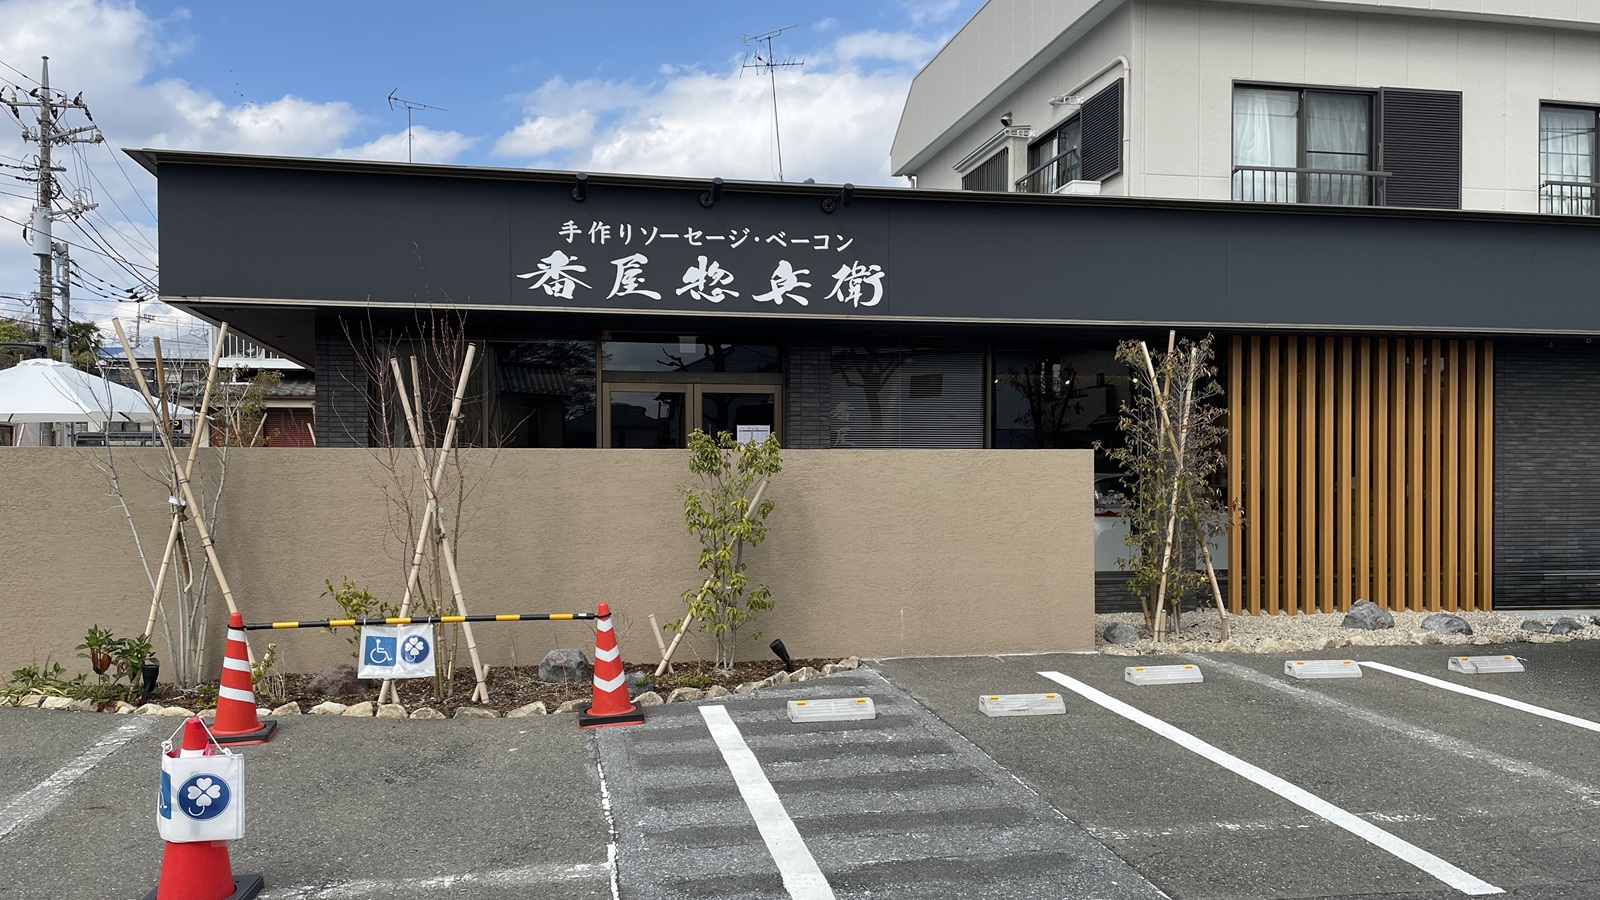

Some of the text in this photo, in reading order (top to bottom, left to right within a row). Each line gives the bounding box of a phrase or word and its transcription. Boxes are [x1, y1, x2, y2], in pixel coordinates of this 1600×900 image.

[558, 219, 854, 252] 手作りソーセージ・ベーコン
[516, 249, 886, 308] 番屋惣兵衛
